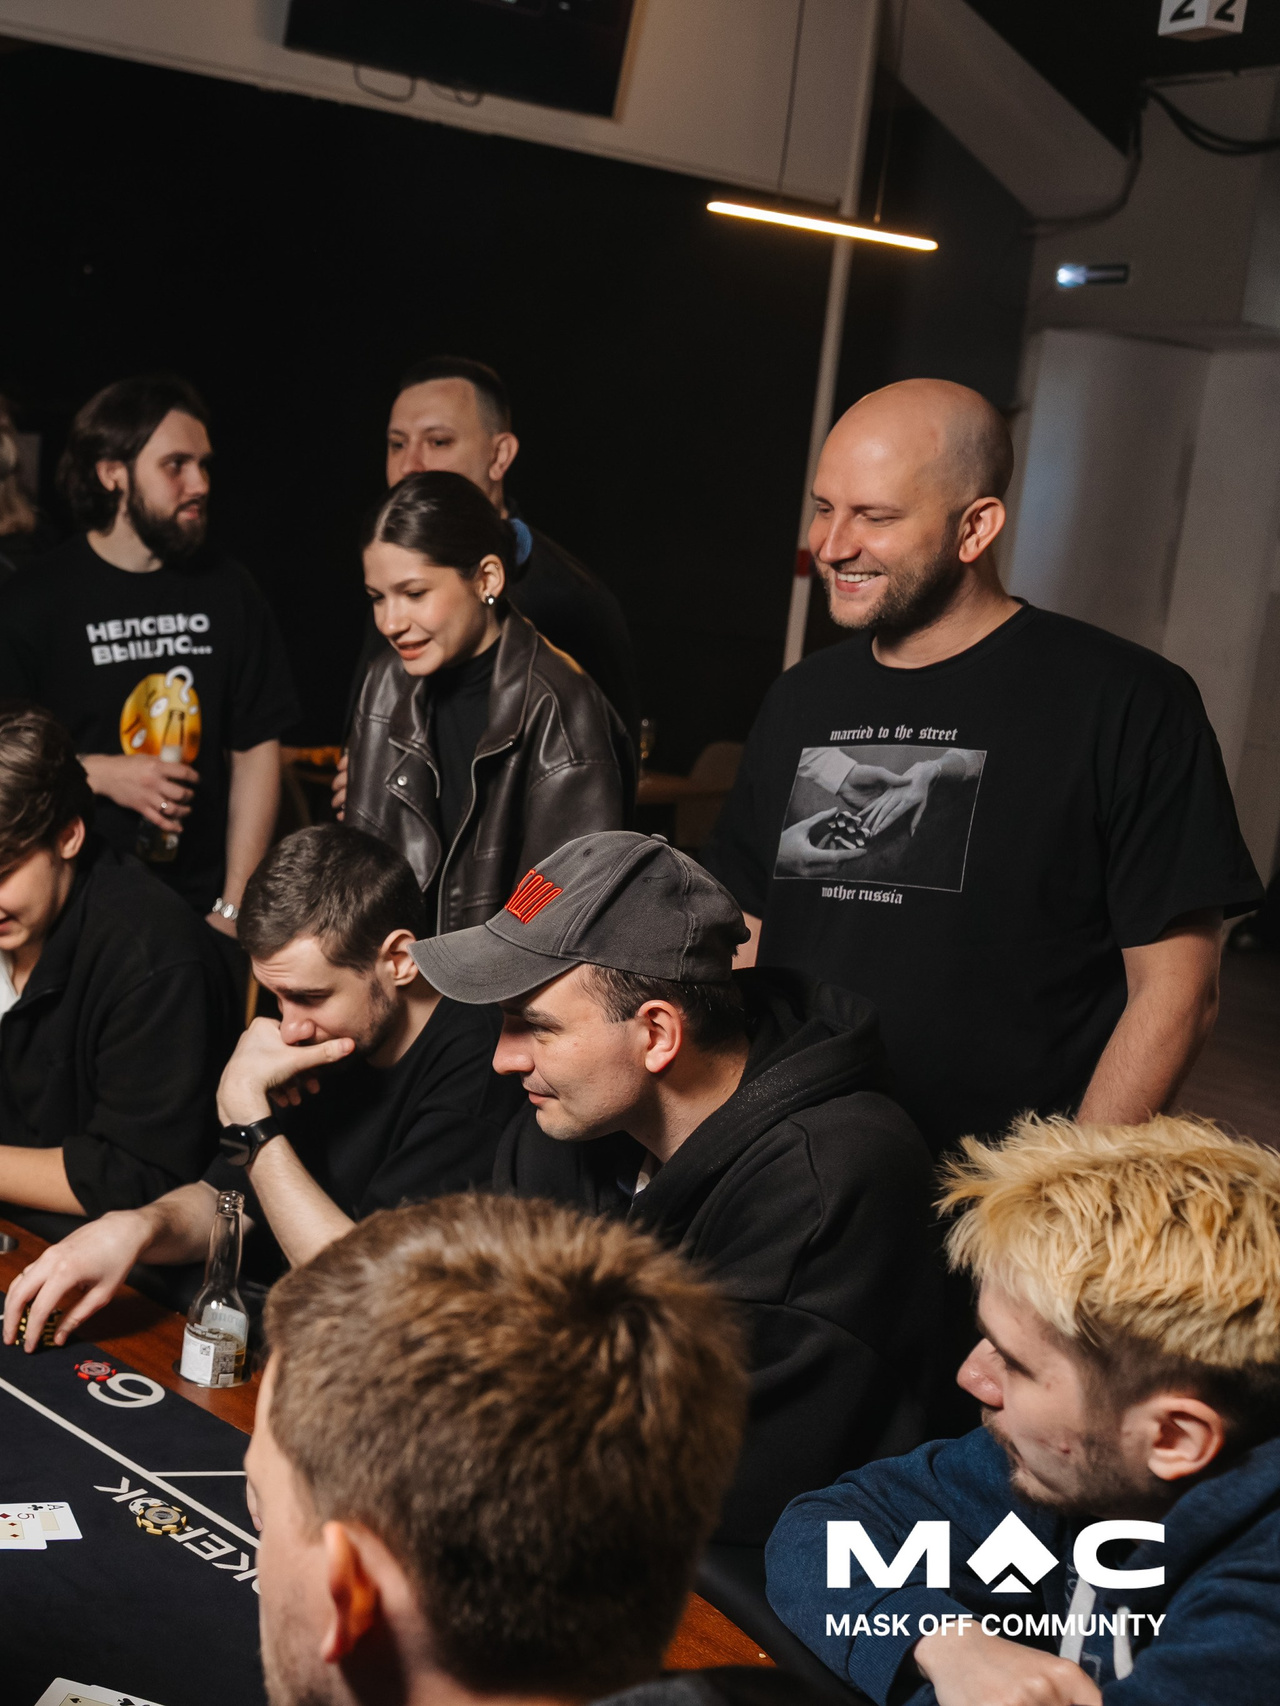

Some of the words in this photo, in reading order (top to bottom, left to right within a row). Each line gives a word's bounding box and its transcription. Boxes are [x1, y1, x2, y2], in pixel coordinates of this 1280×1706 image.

[829, 725, 873, 741] married
[878, 725, 890, 739] to
[894, 724, 913, 740] the
[918, 726, 958, 741] street
[858, 888, 904, 905] russia
[17, 1512, 35, 1520] 5
